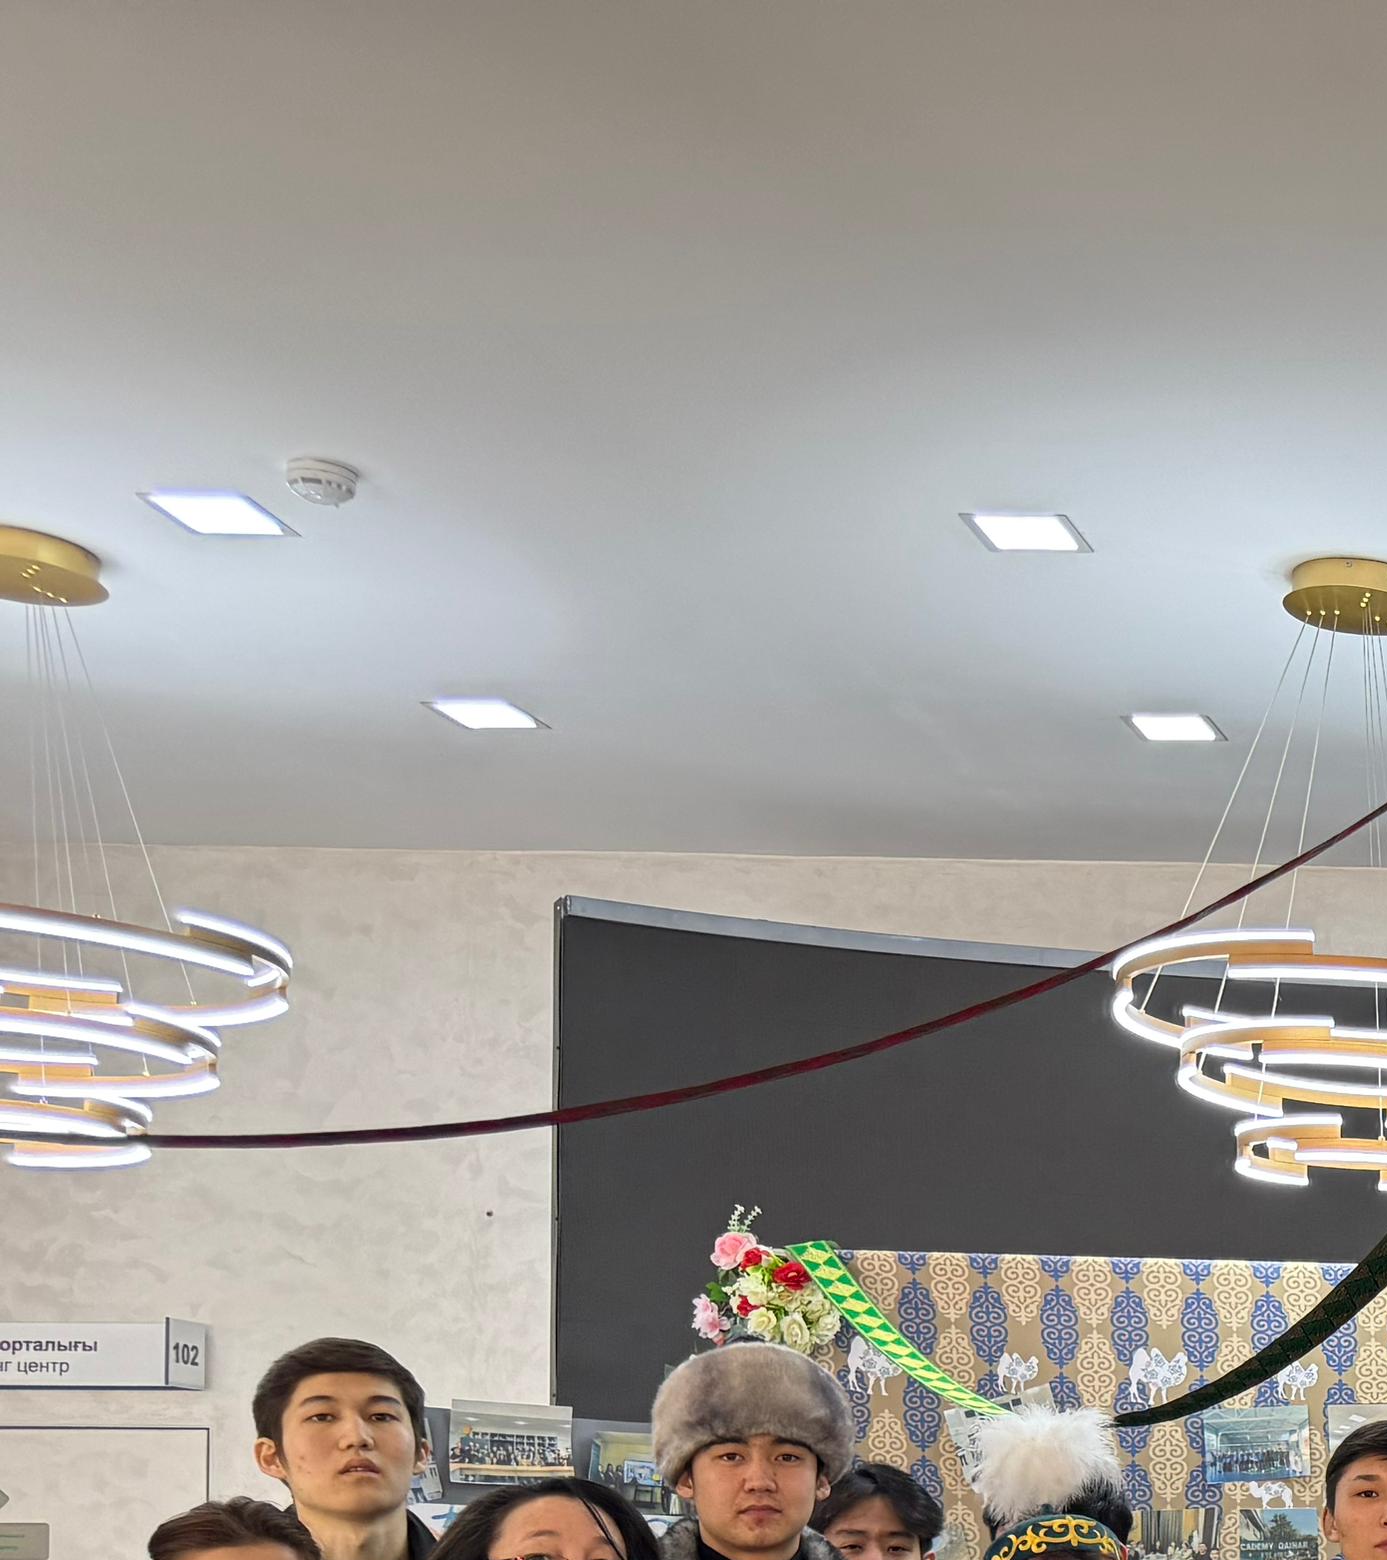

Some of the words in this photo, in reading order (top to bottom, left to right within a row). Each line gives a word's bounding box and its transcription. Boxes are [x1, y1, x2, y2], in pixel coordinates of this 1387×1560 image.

[0, 1340, 98, 1355] орталығы
[173, 1342, 199, 1367] 102
[17, 1361, 70, 1376] центр
